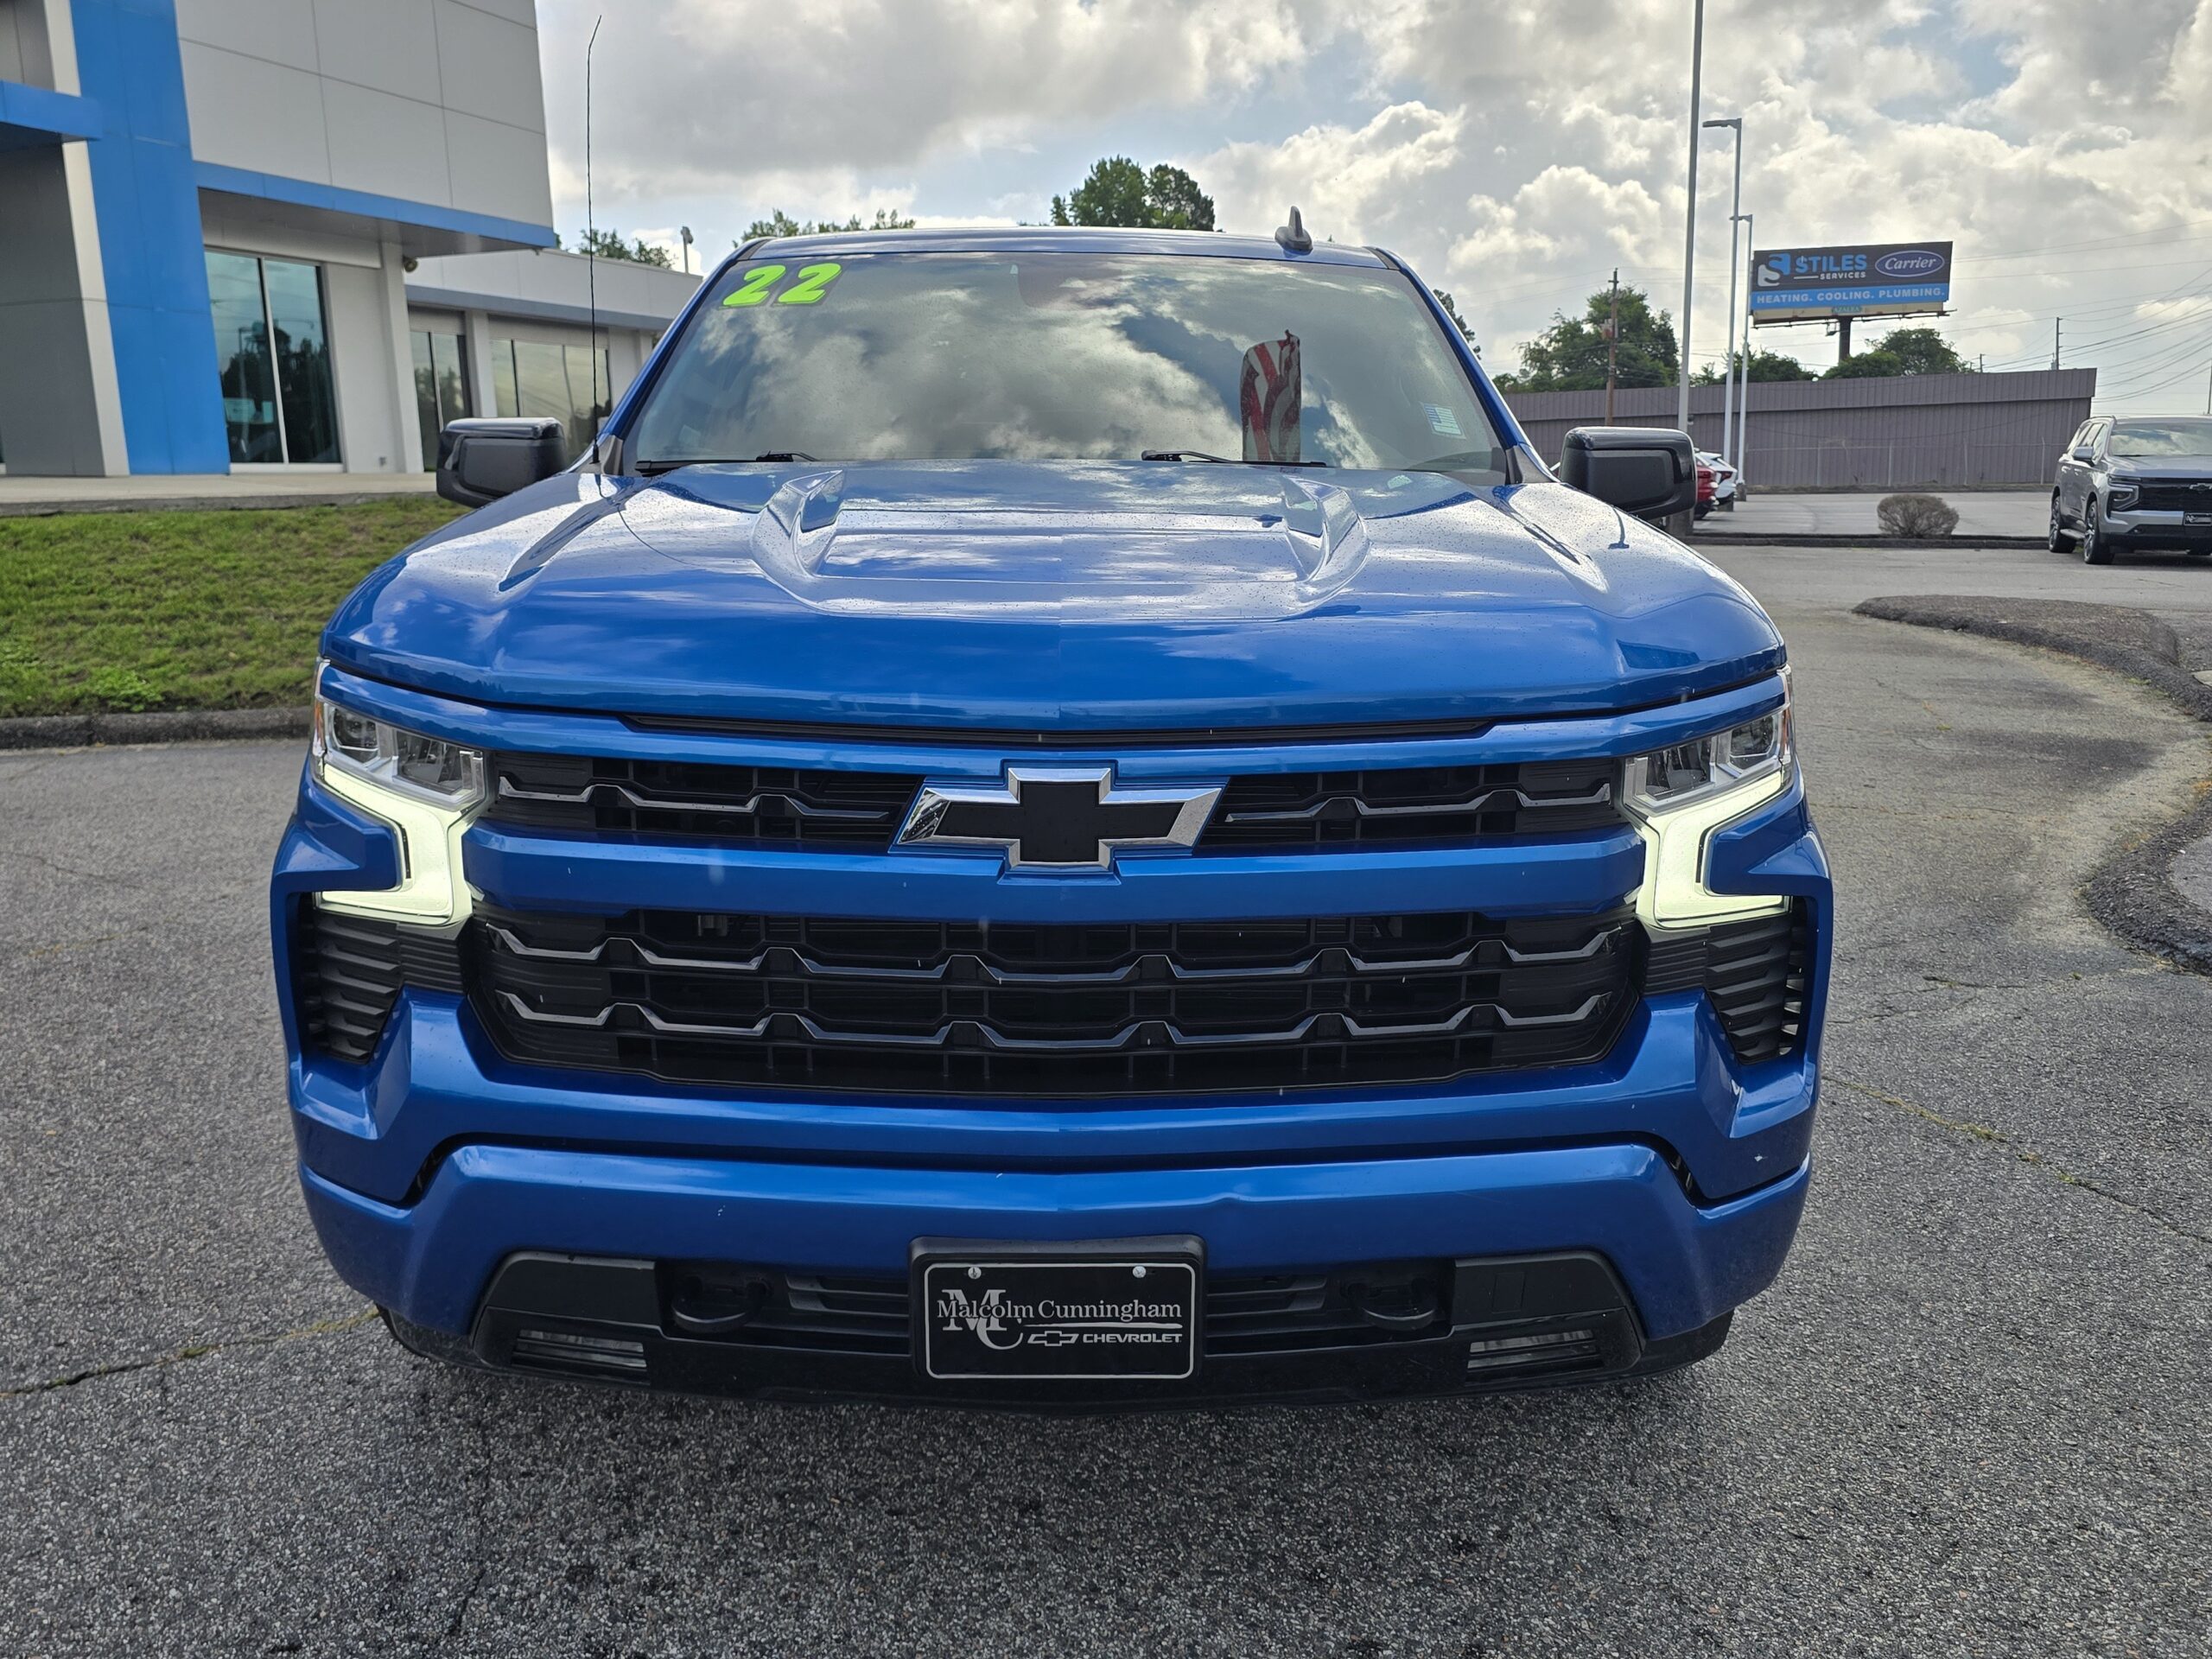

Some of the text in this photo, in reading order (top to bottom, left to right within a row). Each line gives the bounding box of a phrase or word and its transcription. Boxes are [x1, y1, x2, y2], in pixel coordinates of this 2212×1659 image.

[1885, 256, 1936, 270] Carrier
[1820, 271, 1866, 280] SERVICES
[722, 263, 843, 307] 22
[1757, 287, 1945, 304] HEATING. COOLING. PLUMBING.
[937, 1300, 1182, 1322] Malcolm Cunningham
[1082, 1333, 1183, 1343] CHEVROLET
